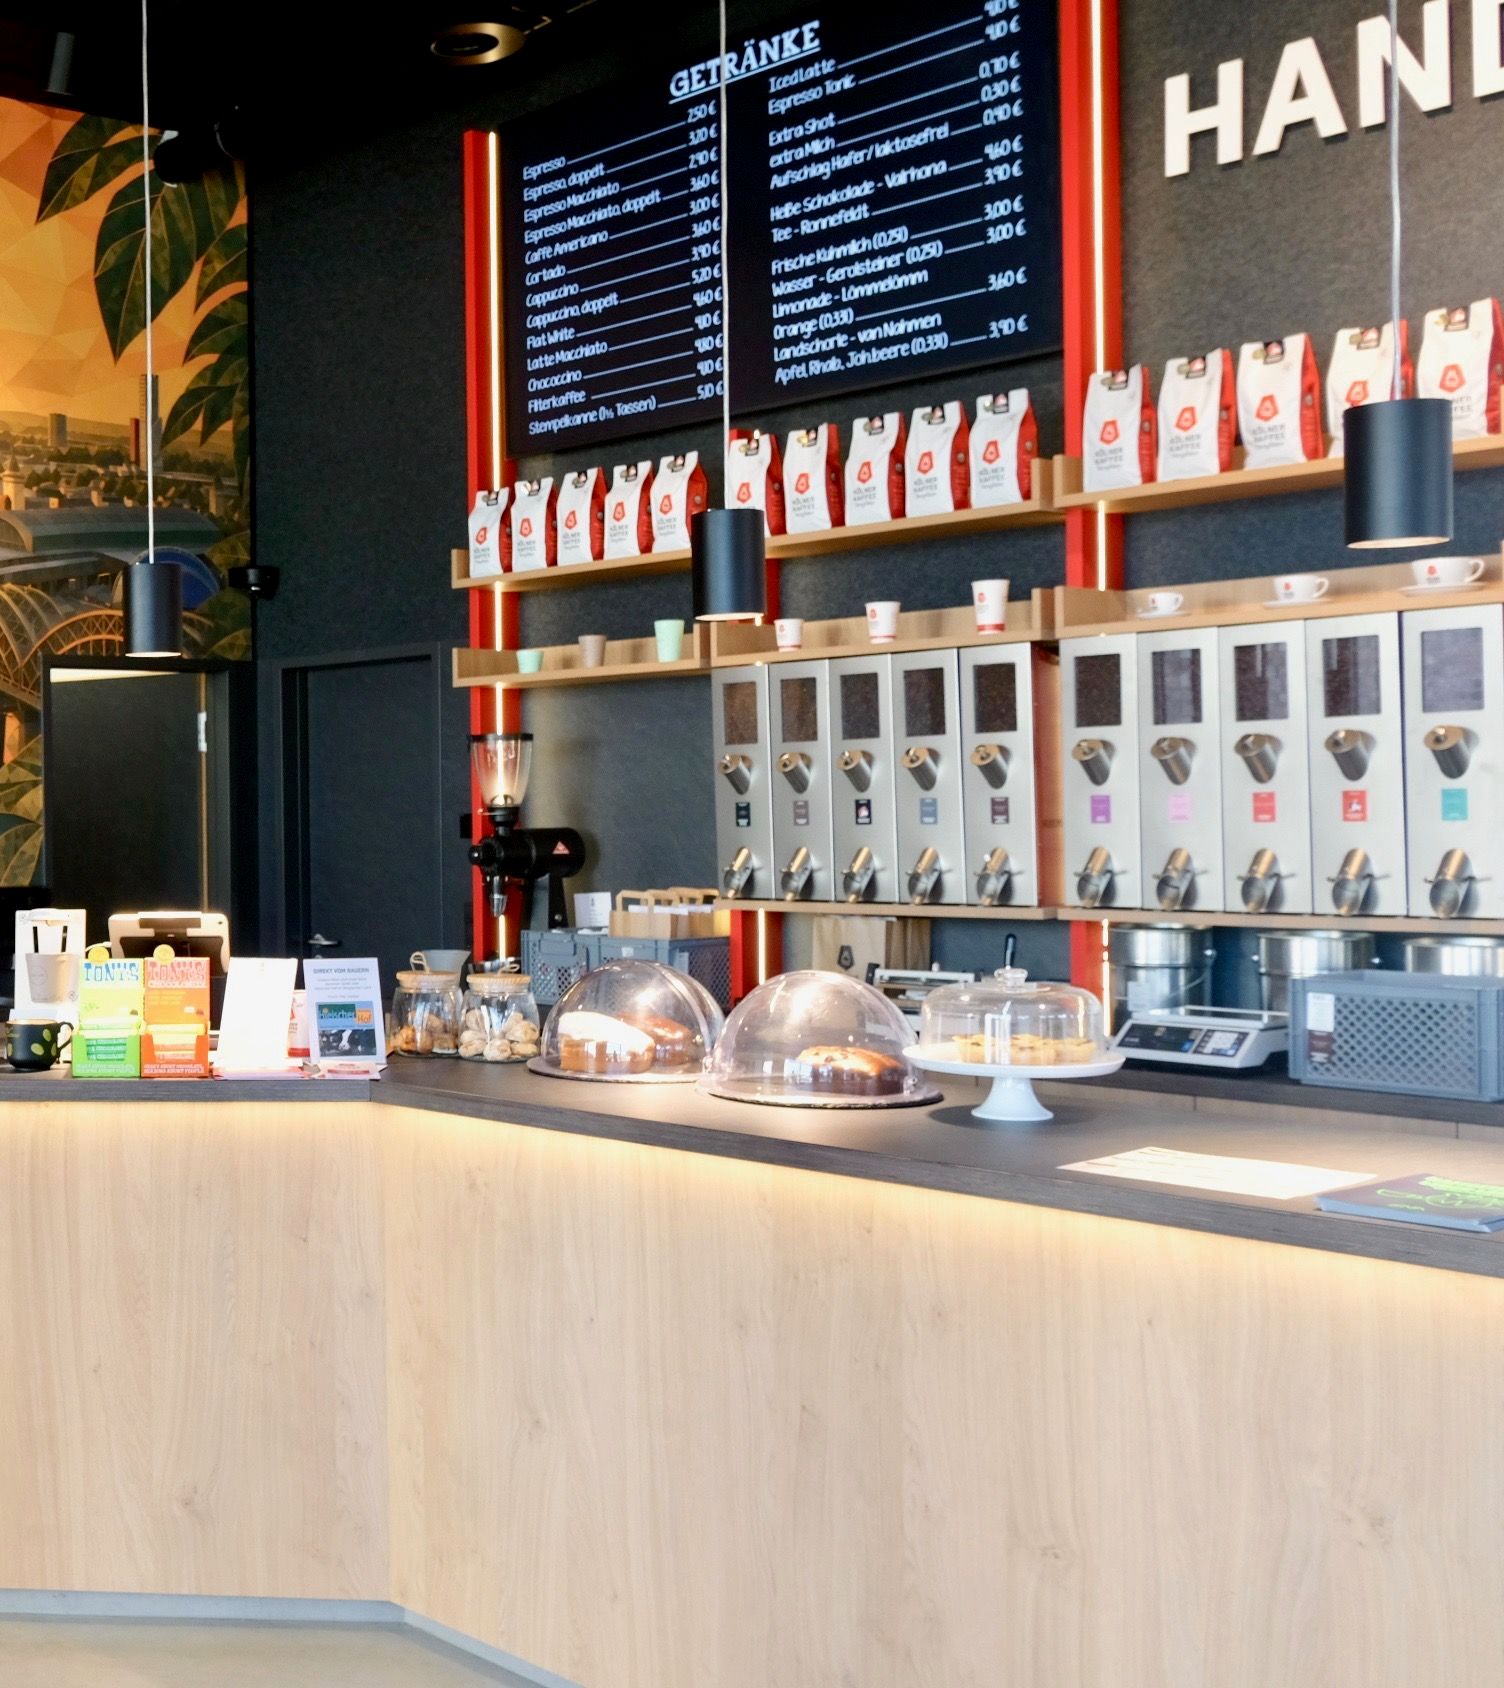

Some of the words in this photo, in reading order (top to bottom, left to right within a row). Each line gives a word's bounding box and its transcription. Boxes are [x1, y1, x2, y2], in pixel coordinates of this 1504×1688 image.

[670, 20, 820, 98] GETRÄNKE
[768, 69, 798, 93] Iced
[799, 59, 836, 83] Latte
[768, 86, 823, 115] Espresso
[824, 74, 856, 95] Tonic
[769, 125, 804, 147] Extra
[805, 112, 836, 135] Shot
[979, 55, 1008, 79] 0,70
[769, 148, 804, 168] extra
[805, 136, 835, 156] Milch
[981, 79, 1009, 102] 0,30
[770, 161, 831, 190] Aufschlag
[832, 149, 868, 171] Hafer
[876, 122, 949, 158] laktosefrei
[983, 103, 1011, 126] 0,40
[523, 157, 566, 180] Espresso
[568, 163, 604, 186] doppelt
[524, 200, 567, 223] Espresso
[567, 182, 620, 209] Macchiato
[770, 201, 802, 222] Heiße
[803, 180, 875, 212] Schokolade
[885, 160, 947, 188] Valrhona
[524, 222, 567, 244] Espresso
[622, 189, 661, 214] doppelt
[772, 226, 792, 243] Tee
[800, 203, 870, 235] Ronnefeldt
[554, 230, 608, 256] Americano
[772, 254, 816, 276] Frische
[816, 237, 872, 264] Kuhmilch
[526, 265, 566, 286] Cortado
[772, 274, 818, 297] Wasser
[826, 252, 904, 283] Gerolsteiner
[526, 283, 579, 309] Cappuccino
[581, 292, 618, 315] doppelt
[772, 292, 832, 318] Limonade
[527, 334, 547, 350] Flat
[547, 327, 576, 347] White
[774, 317, 818, 340] Orange
[774, 332, 848, 362] Landschorle
[857, 326, 883, 343] van
[882, 313, 942, 336] Nahmen
[527, 354, 555, 371] Latte
[555, 341, 608, 364] Macchiato
[528, 370, 582, 392] Chococcino
[528, 390, 586, 413] Filterkaffee
[529, 409, 597, 435] Stempelkanne
[616, 396, 656, 417] Tassen)
